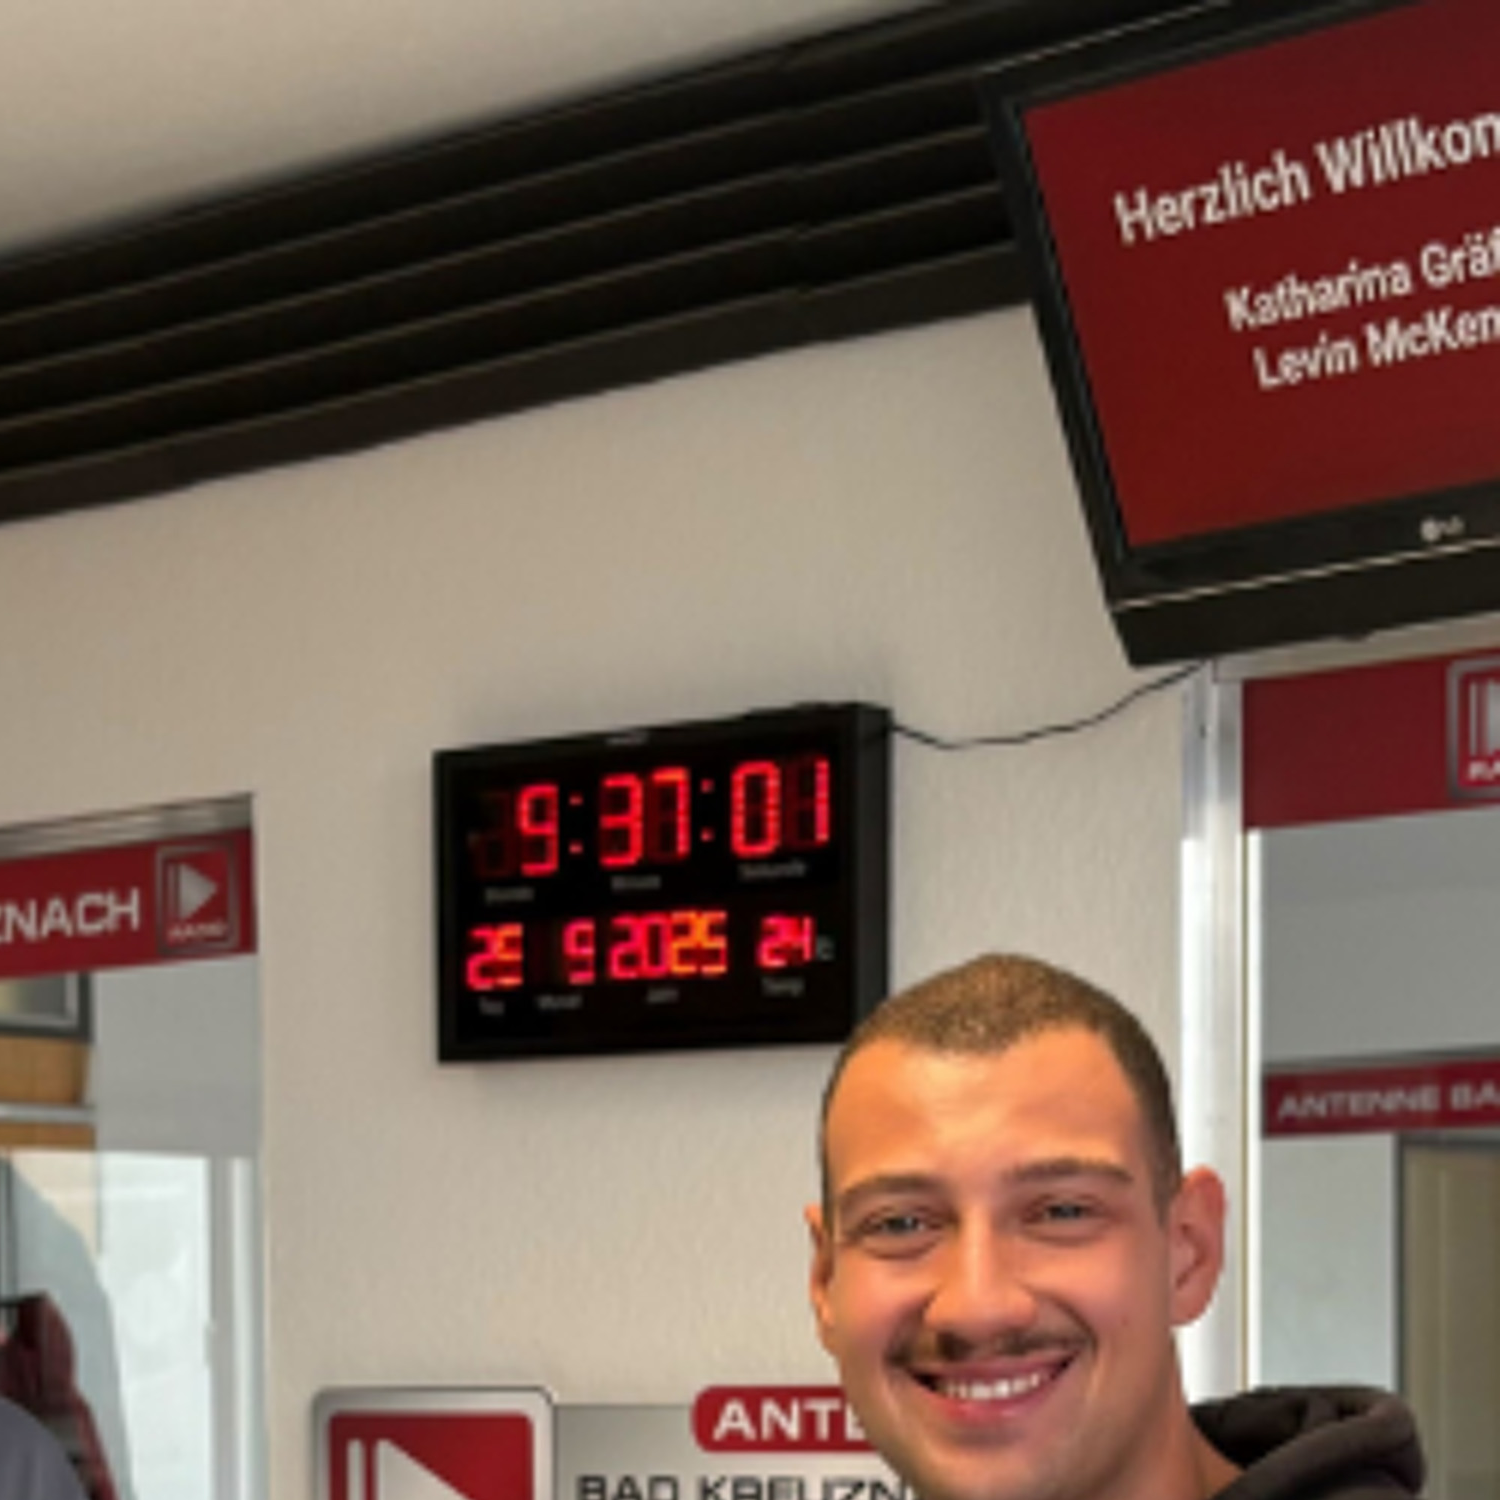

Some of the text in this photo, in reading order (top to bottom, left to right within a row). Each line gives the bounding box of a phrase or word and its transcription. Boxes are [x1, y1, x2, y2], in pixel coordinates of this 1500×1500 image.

[1113, 149, 1311, 247] Herzlich
[1223, 260, 1413, 333] Katharina
[1253, 332, 1359, 390] Levin
[1277, 1084, 1440, 1123] ANTENNE
